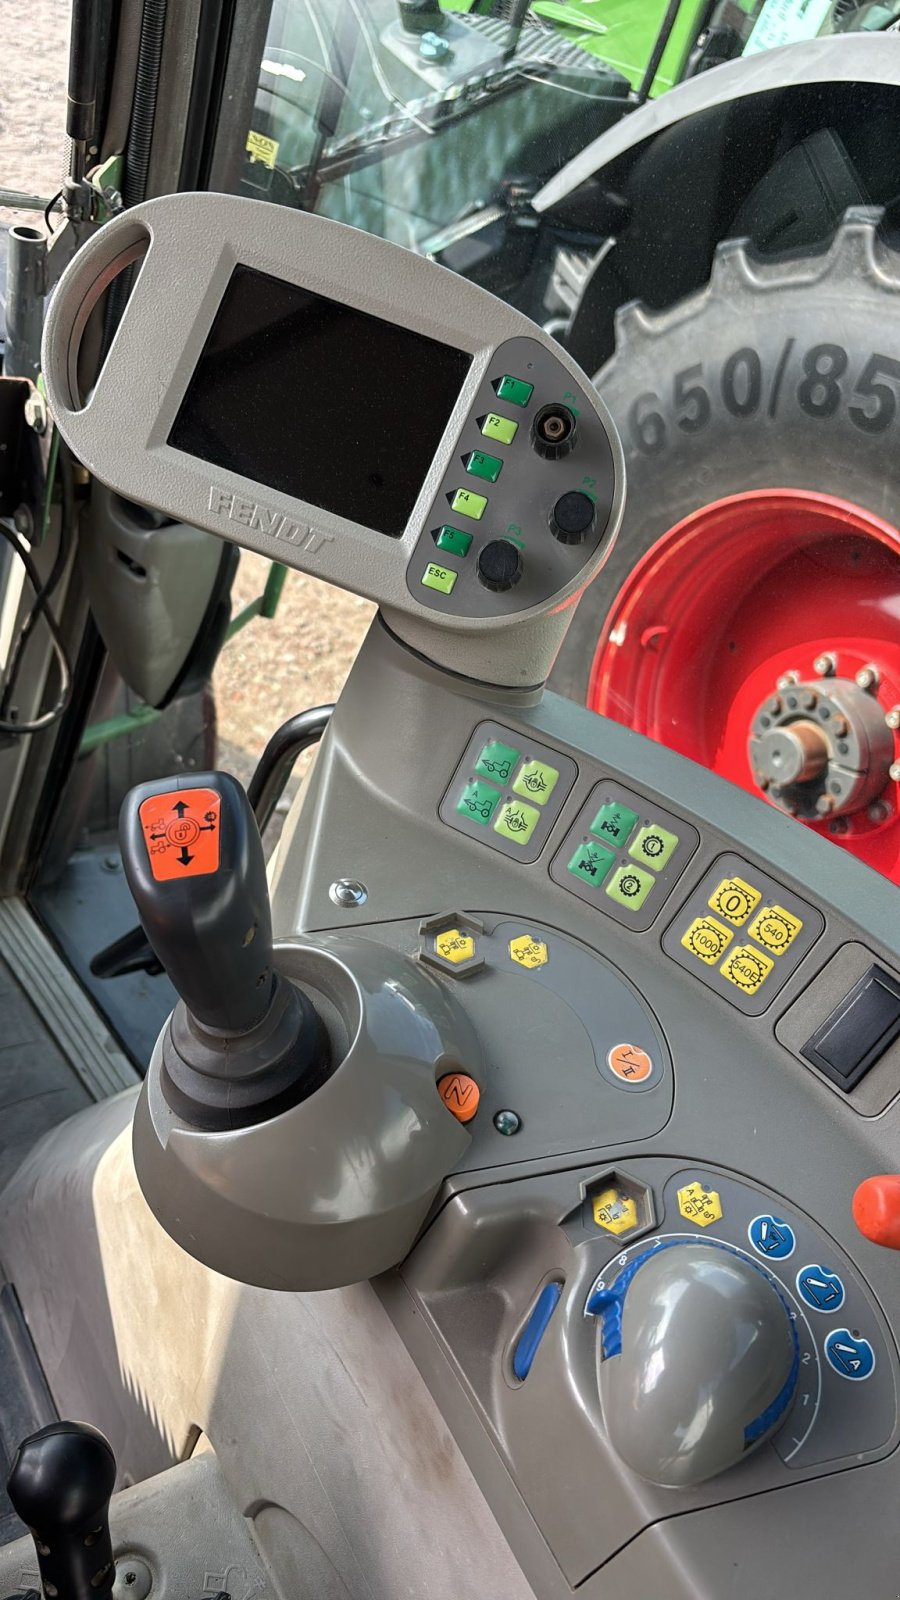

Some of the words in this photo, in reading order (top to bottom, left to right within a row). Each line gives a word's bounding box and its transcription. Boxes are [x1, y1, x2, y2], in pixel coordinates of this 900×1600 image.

[504, 378, 515, 389] F1
[564, 391, 577, 404] P1
[628, 337, 900, 456] 650/85
[488, 417, 500, 427] F2
[473, 454, 486, 464] F3
[582, 476, 597, 489] P2
[458, 491, 470, 502] F4
[208, 485, 335, 554] FENDT
[444, 530, 455, 540] F5
[507, 525, 522, 537] P3
[428, 566, 447, 580] ESC
[505, 807, 512, 815] A
[725, 895, 741, 912] 0
[763, 924, 783, 940] 540
[695, 933, 718, 952] 1000
[733, 961, 759, 982] 540E
[618, 1255, 628, 1266] 8
[802, 1352, 811, 1365] 2
[850, 1360, 861, 1370] A
[803, 1394, 810, 1406] 1
